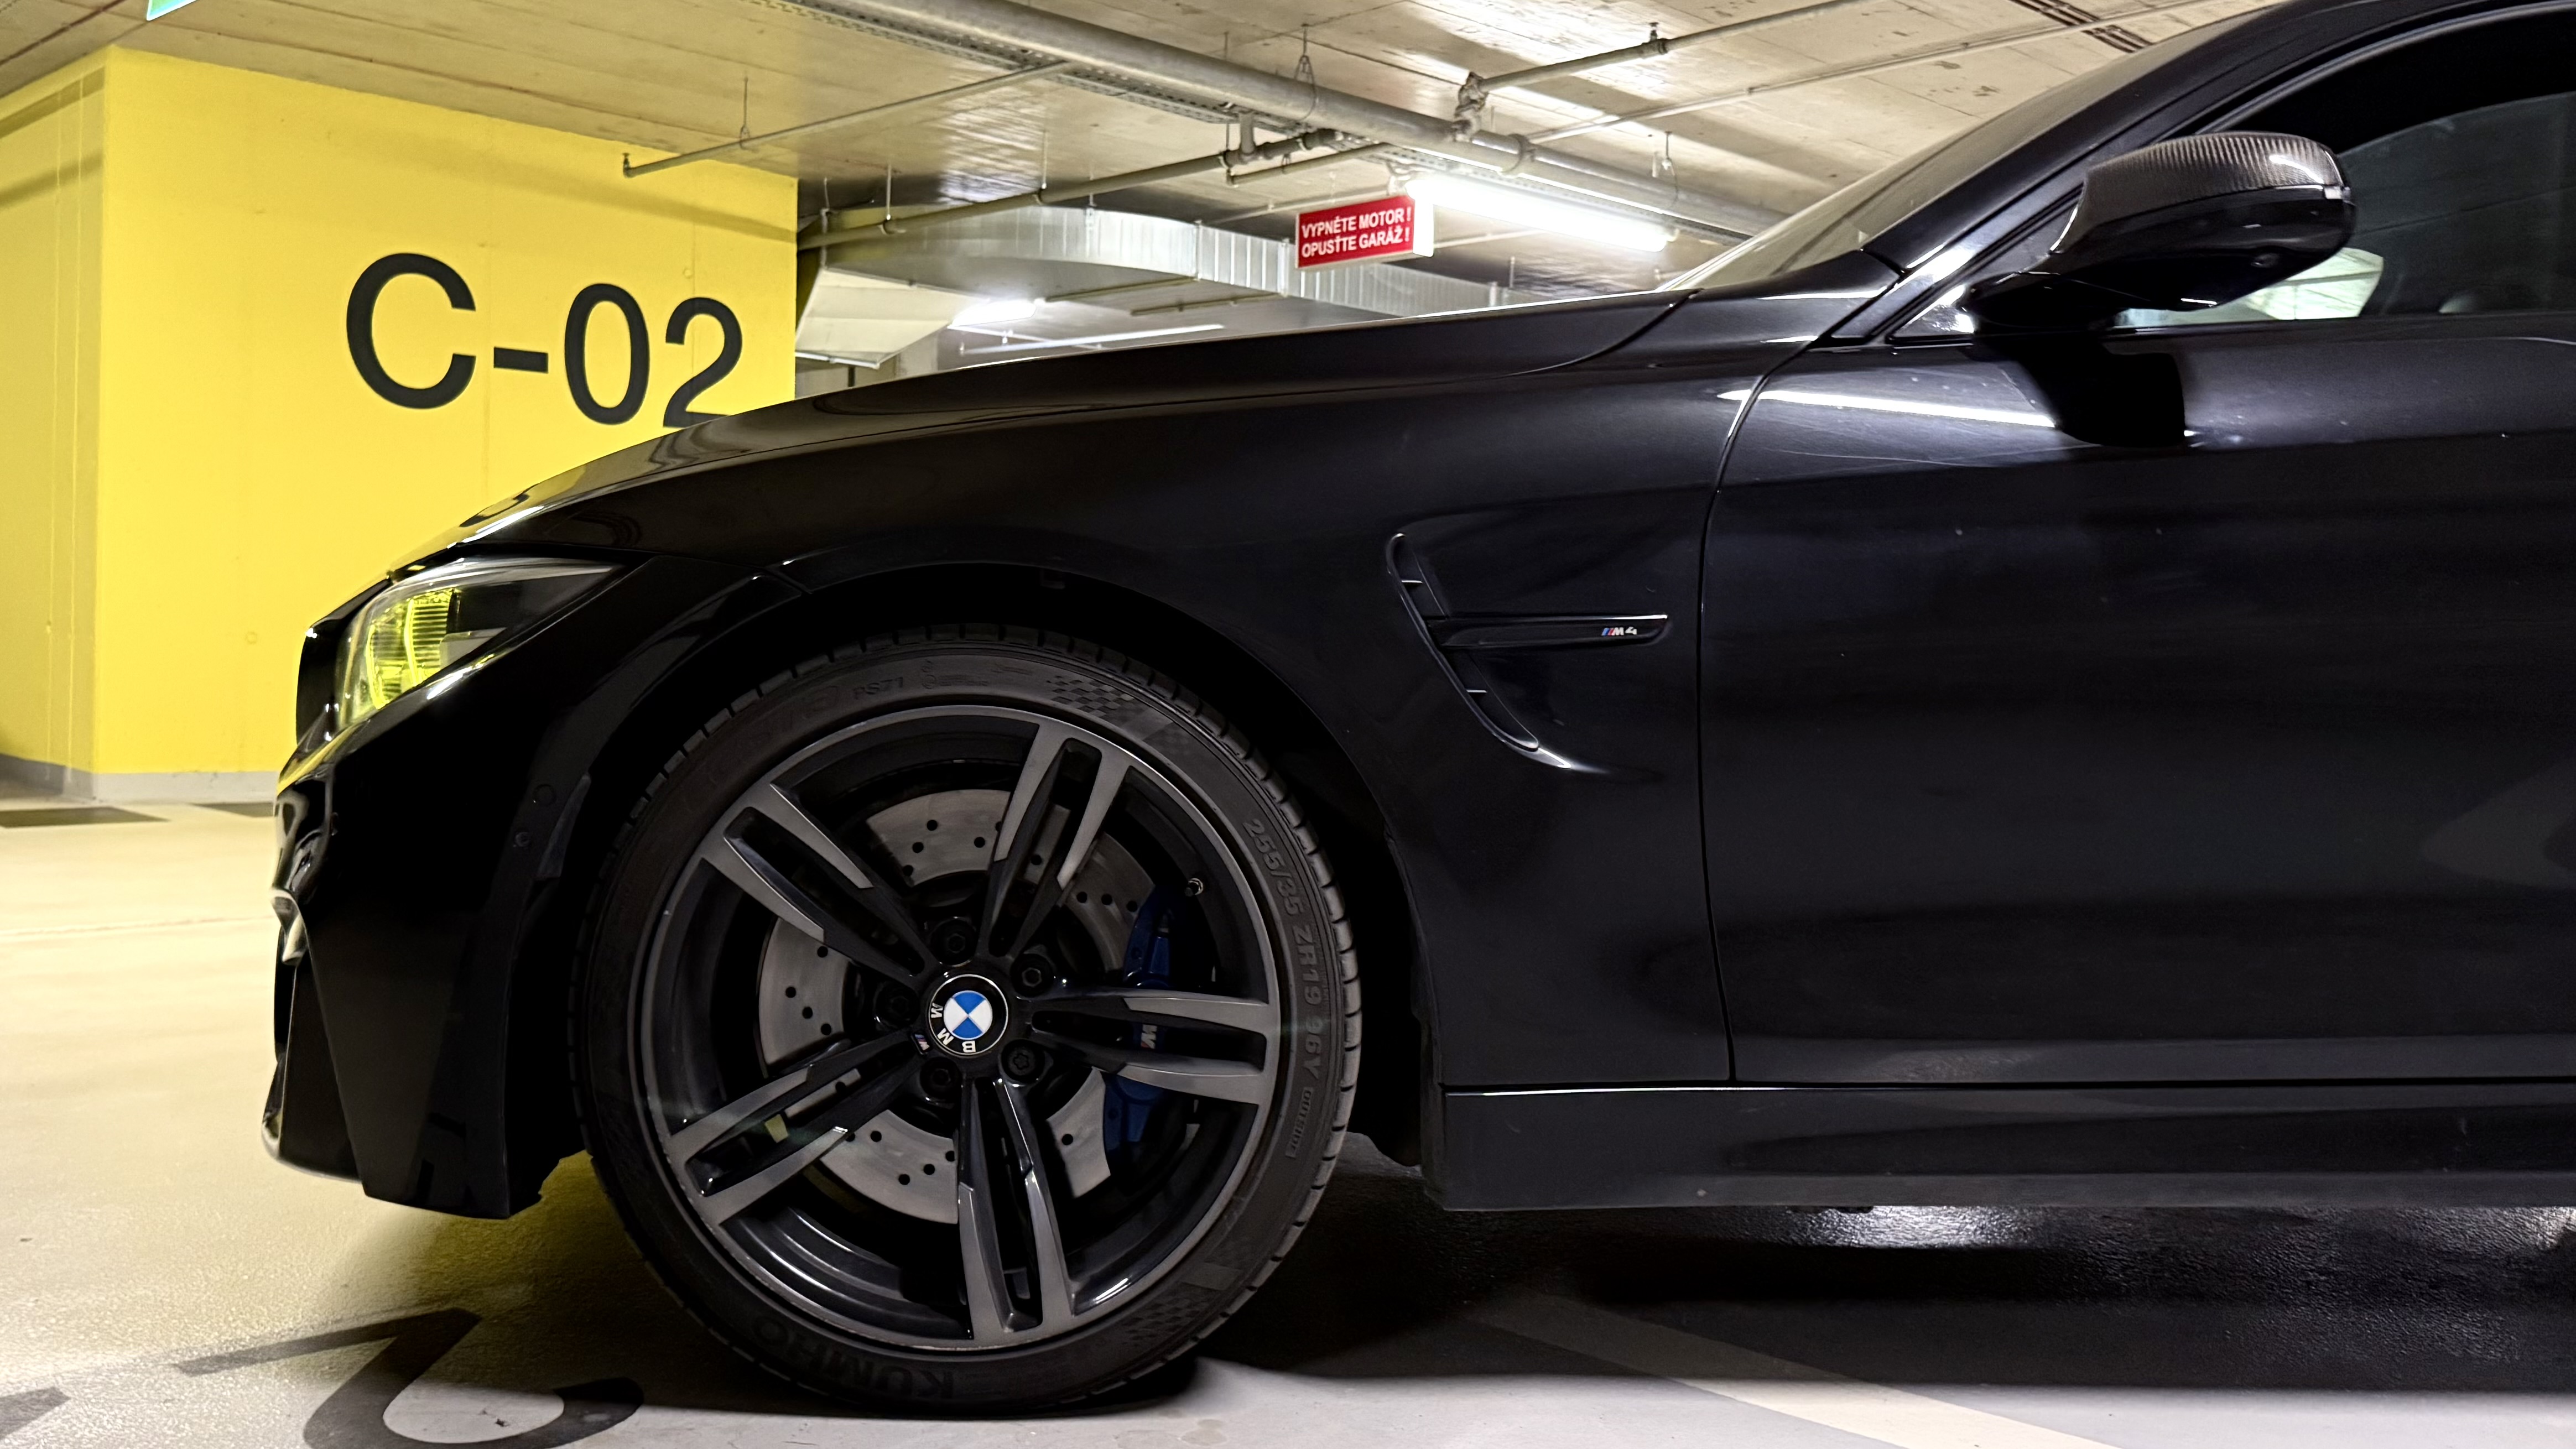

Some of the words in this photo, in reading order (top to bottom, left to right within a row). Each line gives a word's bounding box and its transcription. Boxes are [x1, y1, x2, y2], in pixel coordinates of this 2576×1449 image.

[1359, 207, 1404, 230] MOTOR
[1359, 225, 1403, 249] GARÁŽ
[346, 252, 743, 429] C-02
[851, 676, 904, 700] PS71
[1242, 818, 1306, 916] 255/35
[1292, 924, 1324, 1005] ZR19
[930, 1003, 976, 1053] BMW
[1304, 1016, 1325, 1081] 96Y
